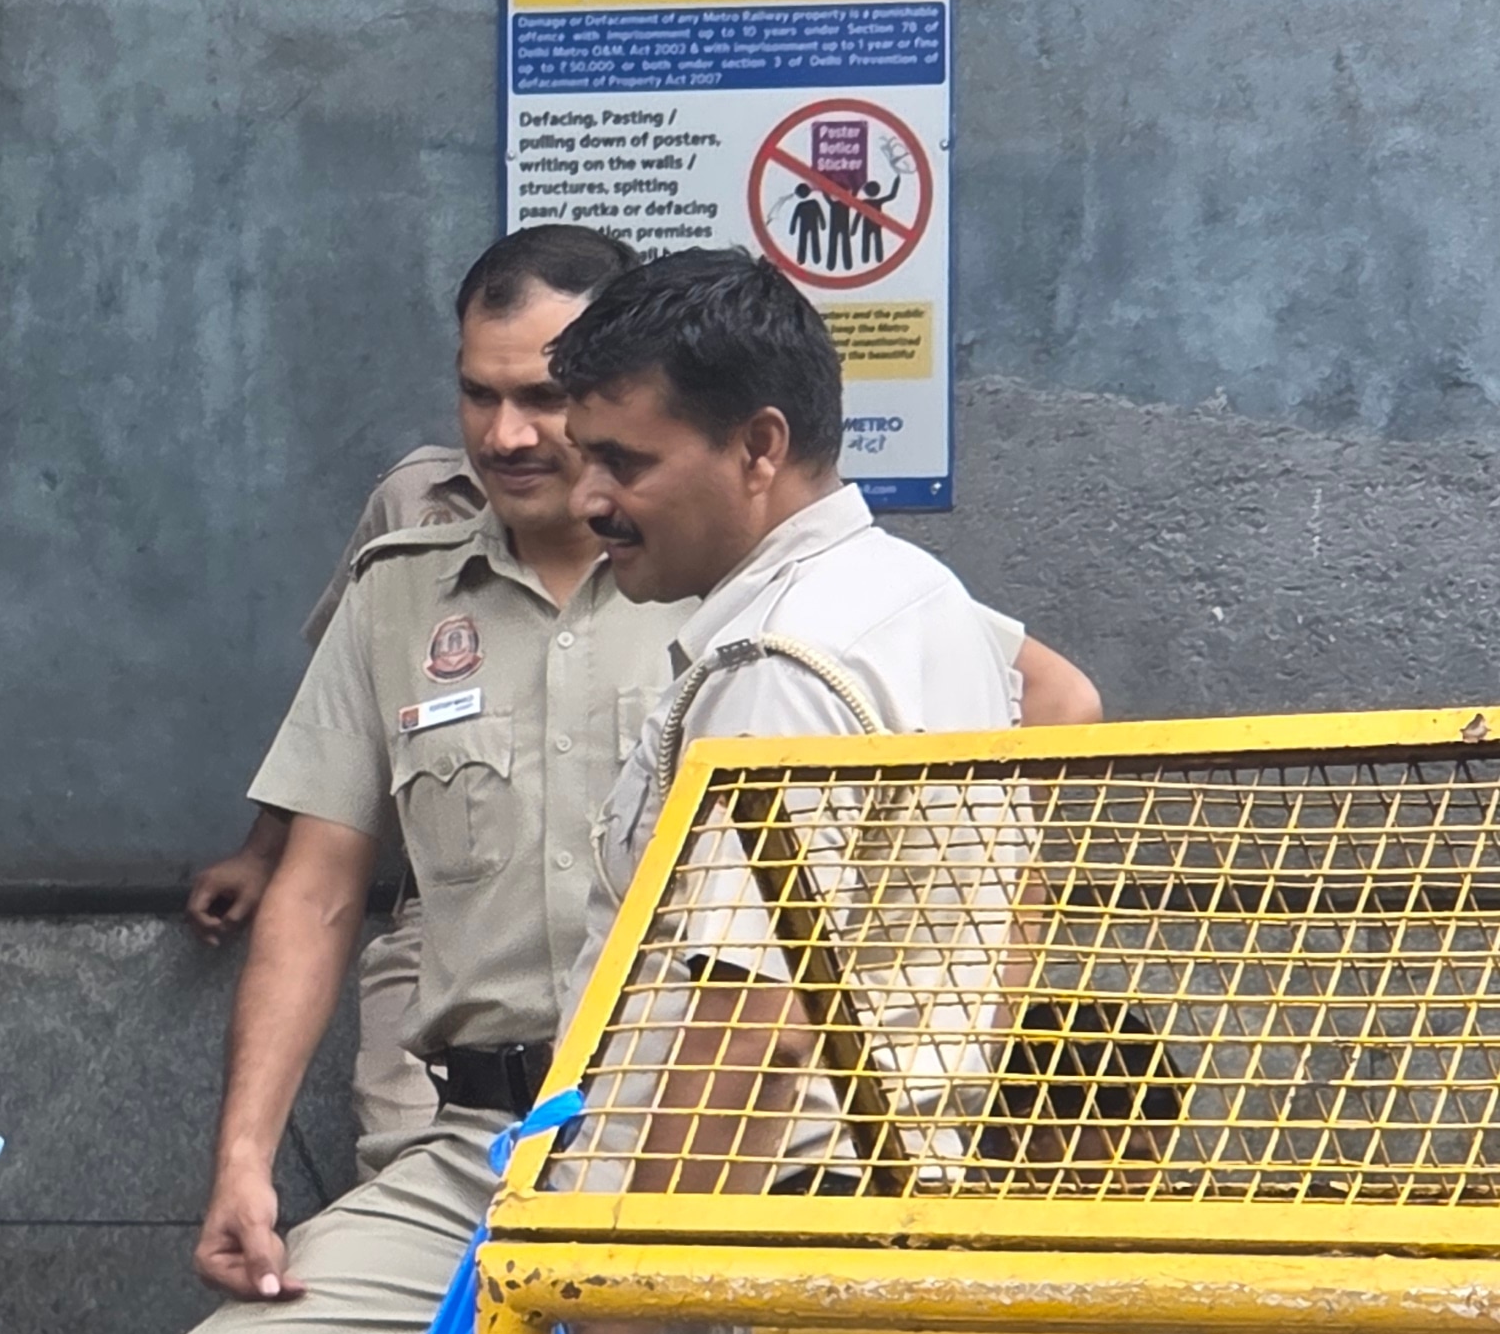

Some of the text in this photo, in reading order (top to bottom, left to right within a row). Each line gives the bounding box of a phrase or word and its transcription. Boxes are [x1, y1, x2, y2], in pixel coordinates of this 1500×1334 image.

[518, 17, 567, 30] Damage
[569, 17, 583, 27] or
[585, 14, 658, 27] Defacement
[661, 13, 675, 24] of
[677, 14, 699, 25] any
[703, 12, 739, 22] Metro
[742, 10, 789, 24] Railway
[792, 9, 846, 23] property
[849, 9, 859, 19] is
[872, 7, 939, 20] punishable
[518, 31, 565, 43] offence
[572, 30, 600, 41] with
[606, 28, 691, 42] imprisonment
[698, 28, 715, 40] up
[721, 27, 736, 38] to
[742, 25, 758, 38] 10
[763, 27, 798, 40] years
[804, 24, 840, 36] under
[847, 22, 894, 35] Section
[924, 20, 939, 33] of
[518, 47, 550, 58] Delhi
[552, 46, 589, 57] Metro
[629, 43, 650, 56] Act
[654, 42, 686, 56] 2002
[703, 42, 730, 53] with
[733, 41, 818, 54] imprisonment
[821, 41, 838, 52] up
[841, 39, 855, 51] to
[858, 38, 864, 50] 1
[867, 40, 894, 52] year
[897, 39, 911, 49] or
[914, 36, 938, 48] fine
[518, 64, 534, 75] up
[541, 63, 555, 73] to
[621, 61, 635, 72] or
[642, 59, 671, 71] both
[677, 58, 714, 70] under
[721, 58, 766, 69] section
[774, 55, 782, 68] 3
[788, 55, 803, 67] of
[809, 54, 842, 67] Delhi
[849, 53, 917, 66] Prevention
[924, 52, 938, 64] of
[518, 72, 722, 89] defacement of Property Act 2007
[519, 108, 677, 128] Defacing, Pasting /
[819, 125, 860, 138] Poster
[519, 131, 721, 153] pulling down of posters,
[819, 141, 860, 155] Notice
[519, 153, 697, 175] writing on the walls /
[817, 157, 862, 171] Sticker
[519, 178, 678, 197] structures, spitting
[572, 203, 619, 221] gutka
[623, 204, 641, 216] or
[645, 200, 718, 218] defacing
[636, 223, 713, 242] premises
[852, 310, 872, 320] and
[874, 309, 891, 319] the
[892, 308, 924, 321] public
[858, 323, 875, 333] the
[878, 323, 910, 333] Metro
[843, 416, 903, 432] METRO
